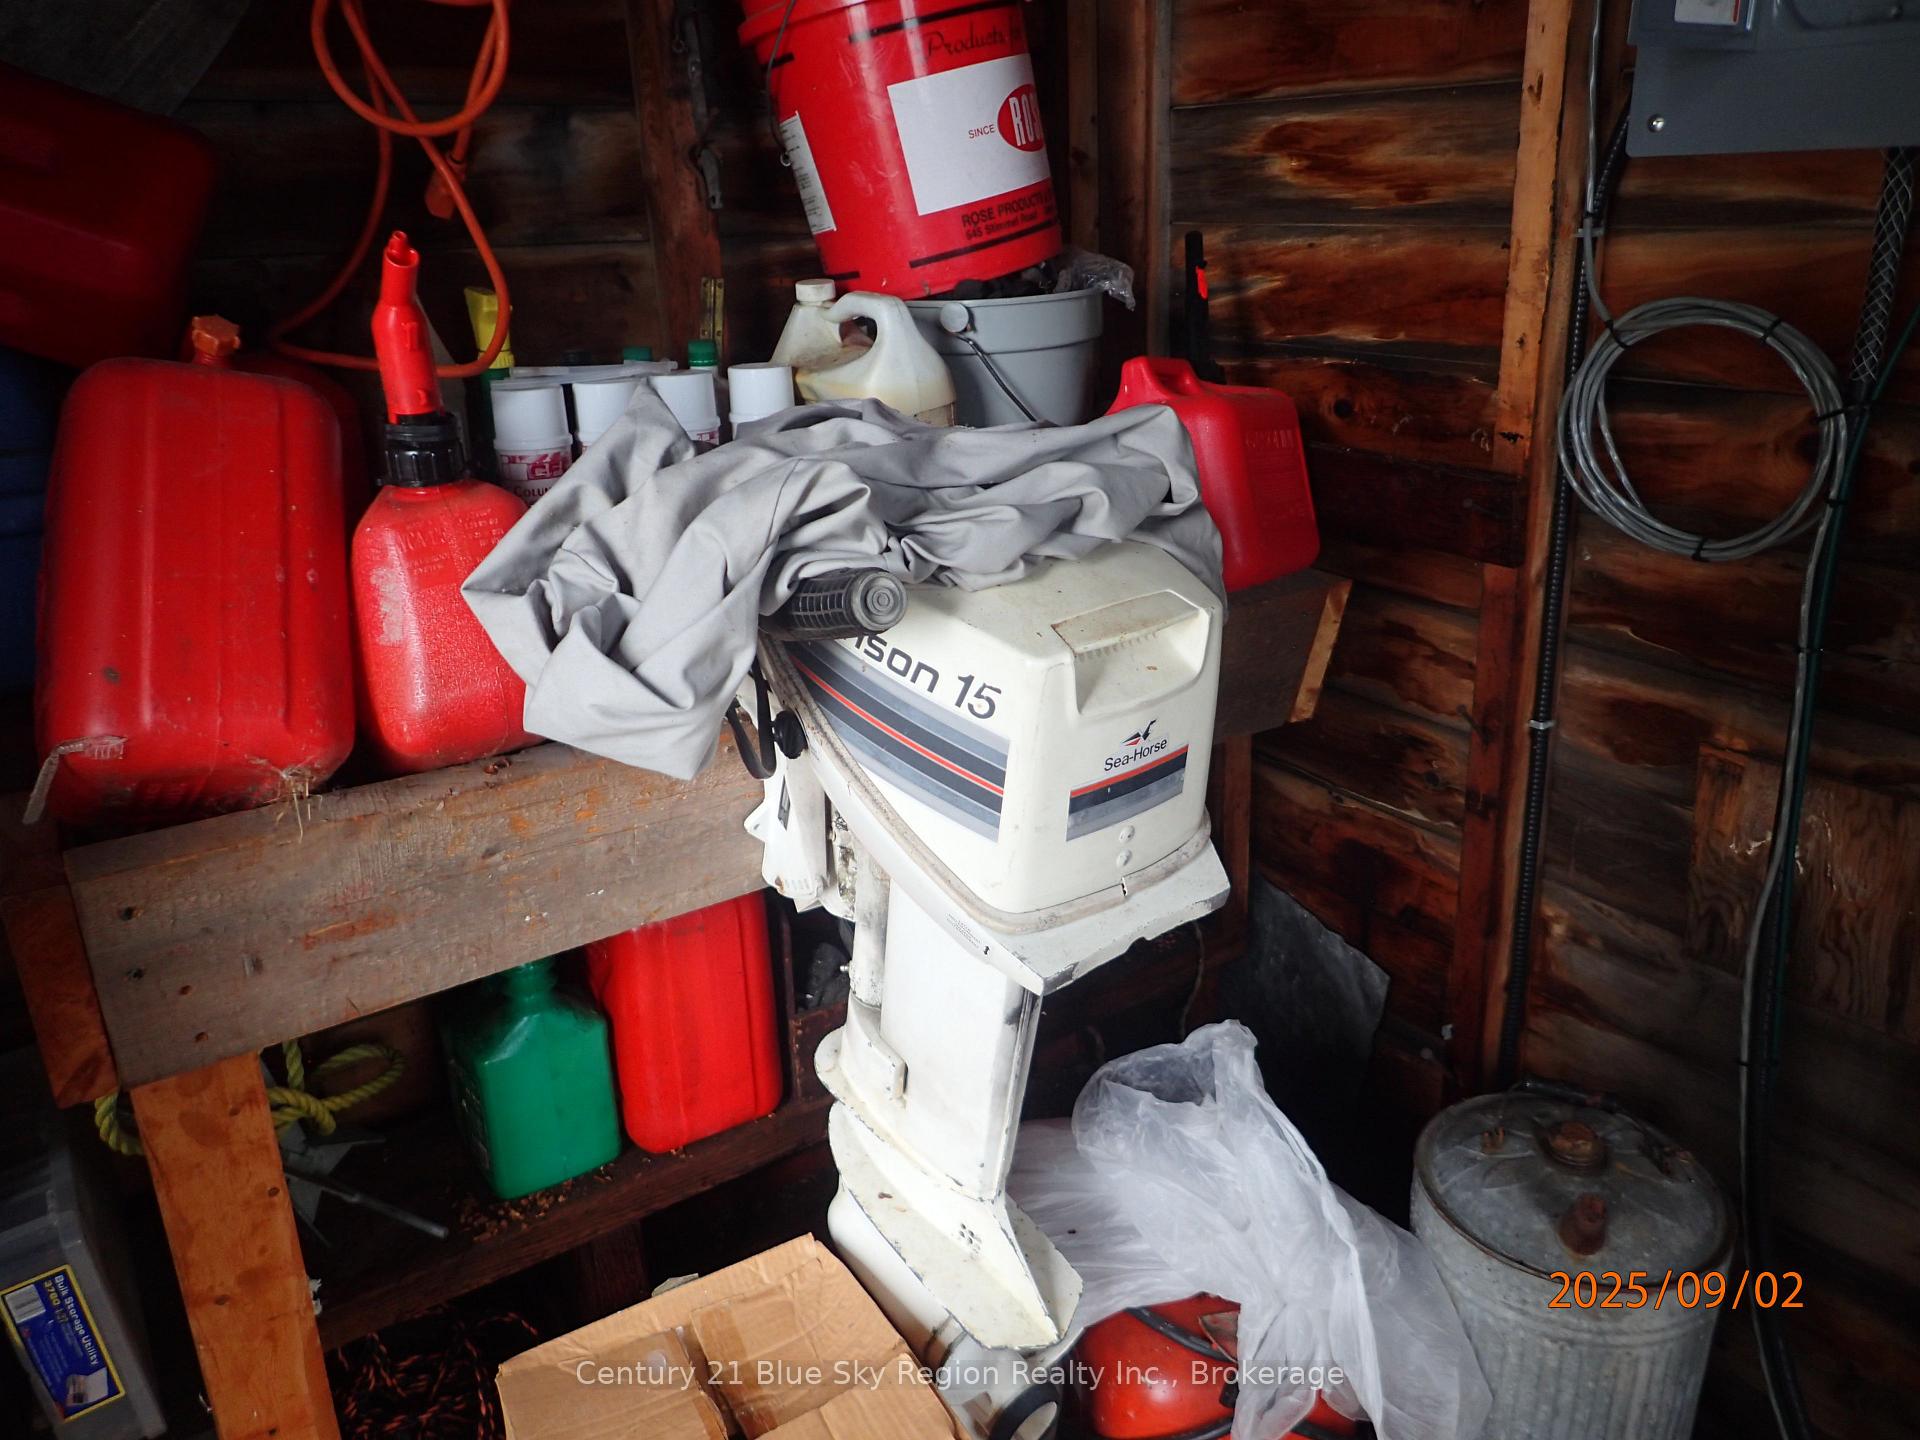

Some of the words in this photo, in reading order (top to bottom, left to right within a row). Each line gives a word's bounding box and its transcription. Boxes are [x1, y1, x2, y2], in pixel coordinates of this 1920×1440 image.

[968, 124, 995, 139] SINCE
[961, 207, 994, 229] ROSE
[955, 674, 1002, 719] 15
[1104, 739, 1167, 771] Sea-Horse
[54, 1274, 70, 1296] Bulk
[64, 1296, 86, 1336] Storage
[81, 1335, 99, 1366] Utility
